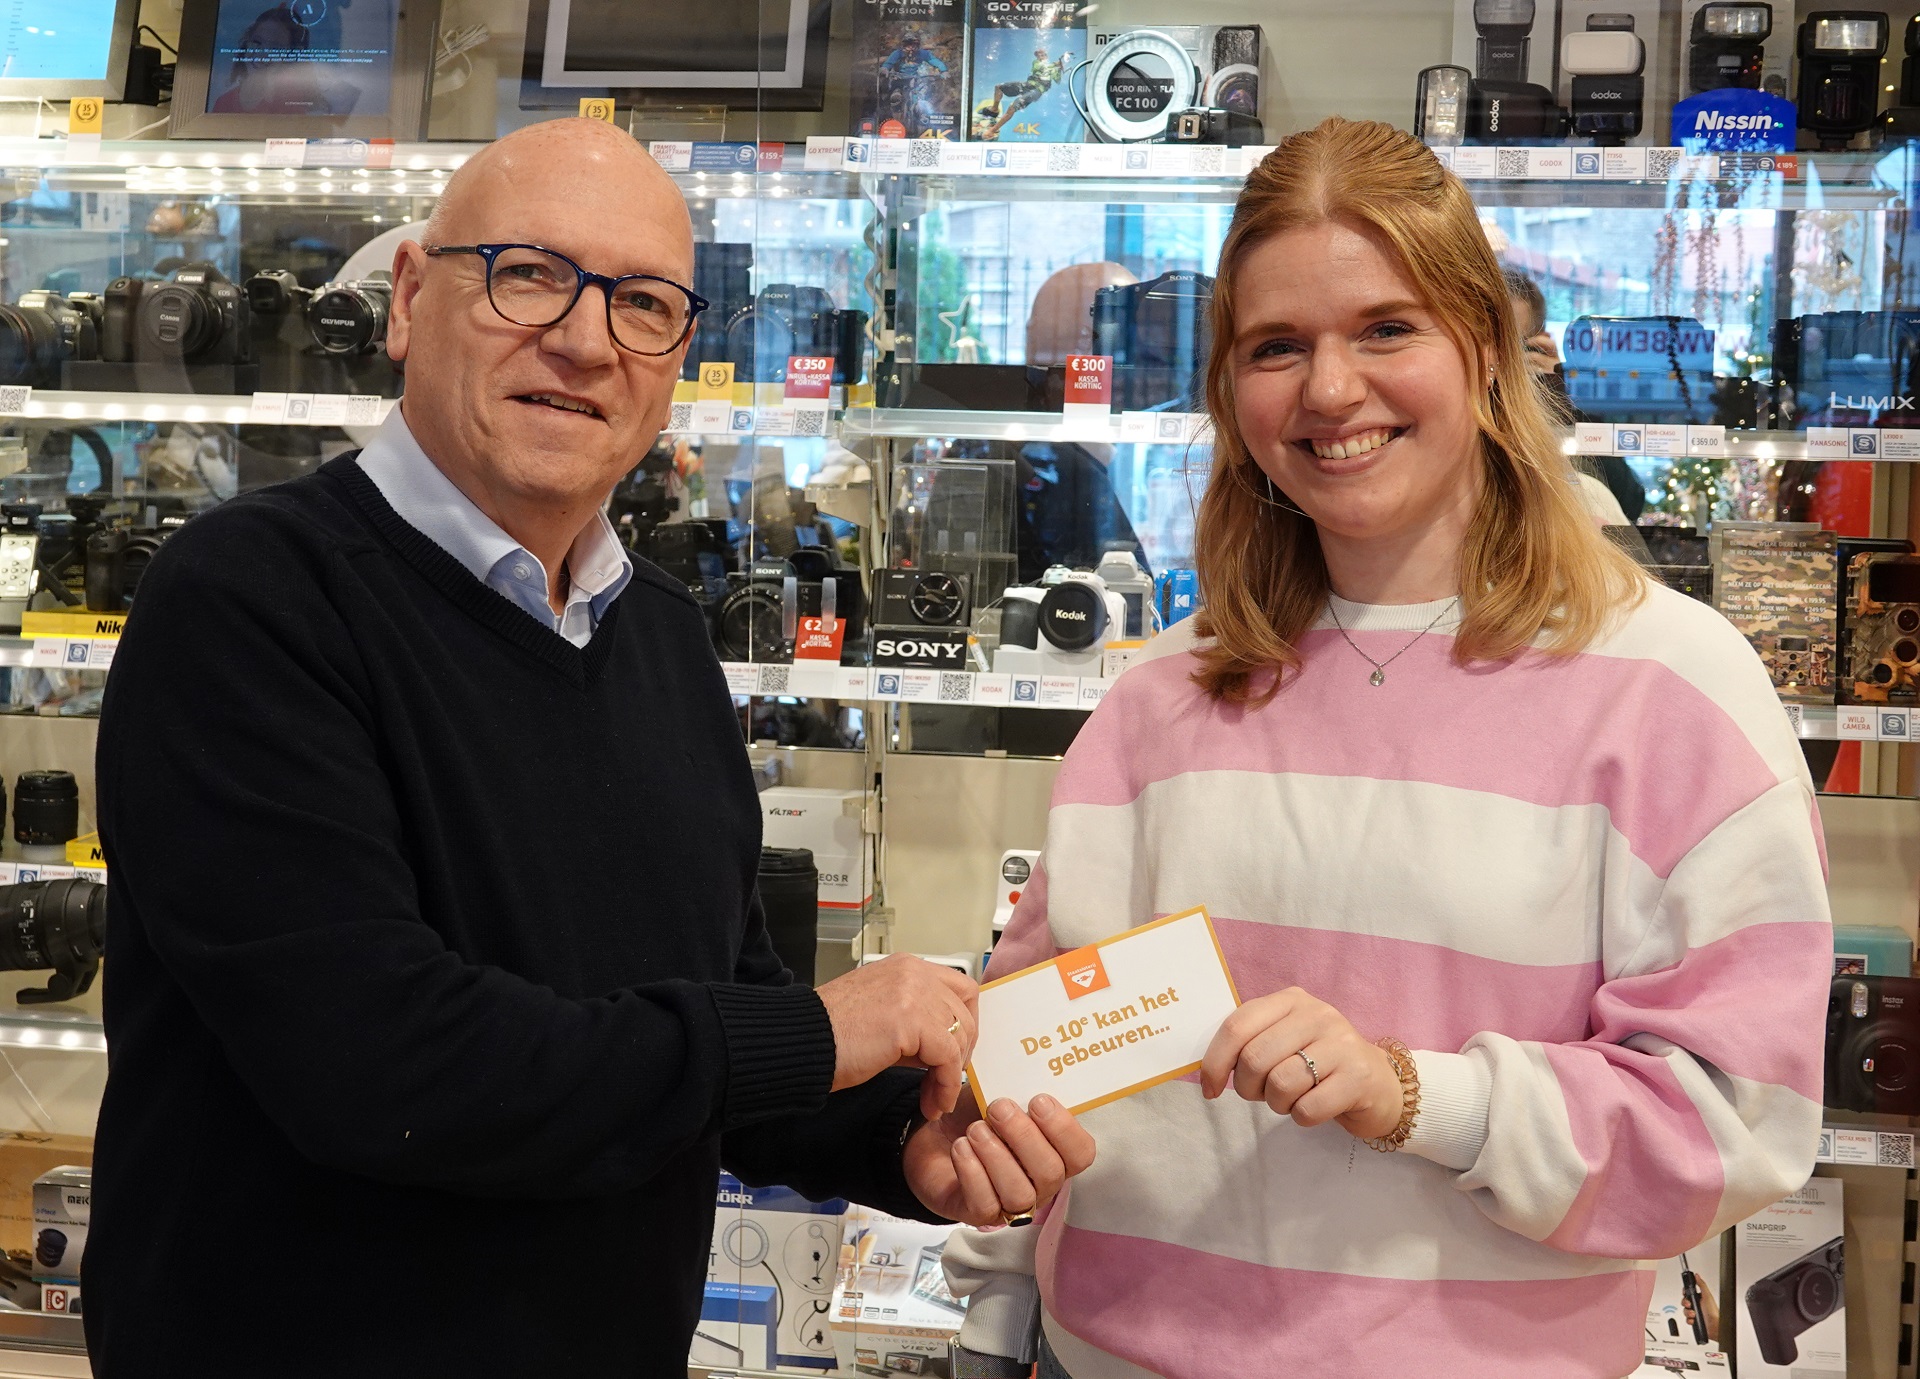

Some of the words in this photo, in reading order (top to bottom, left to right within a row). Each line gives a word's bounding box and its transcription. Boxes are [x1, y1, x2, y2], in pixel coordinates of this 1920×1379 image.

[1110, 85, 1134, 93] ACRO
[1160, 85, 1175, 93] FLA
[1591, 90, 1622, 100] Godox
[1116, 98, 1131, 108] FC
[1135, 98, 1158, 108] 100
[592, 106, 602, 114] 35
[1490, 99, 1500, 132] Godox
[1695, 111, 1772, 130] Nissin
[919, 128, 953, 139] 4K
[1013, 123, 1041, 135] 4K
[177, 274, 202, 282] Canon
[19, 300, 45, 308] Canon
[160, 314, 180, 322] Canon
[320, 318, 355, 326] OLYMPUS
[712, 370, 721, 378] 35
[1074, 382, 1102, 390] KORTING
[1831, 391, 1915, 410] LUMIX
[162, 517, 186, 525] Nikon
[1055, 609, 1087, 622] Kodak
[96, 620, 122, 634] Nik
[805, 640, 832, 648] KORTING
[876, 640, 963, 658] SONY
[819, 874, 840, 882] EOS
[842, 874, 848, 882] R
[1882, 995, 1904, 1004] instax
[1020, 1032, 1052, 1056] De
[1092, 1003, 1138, 1029] kan
[1139, 986, 1180, 1014] het
[1047, 1020, 1171, 1077] gebeuren...
[717, 1189, 753, 1205] ÖRR
[1746, 1223, 1787, 1232] SNAPGRIP
[867, 1336, 944, 1346] CYBERSCAN
